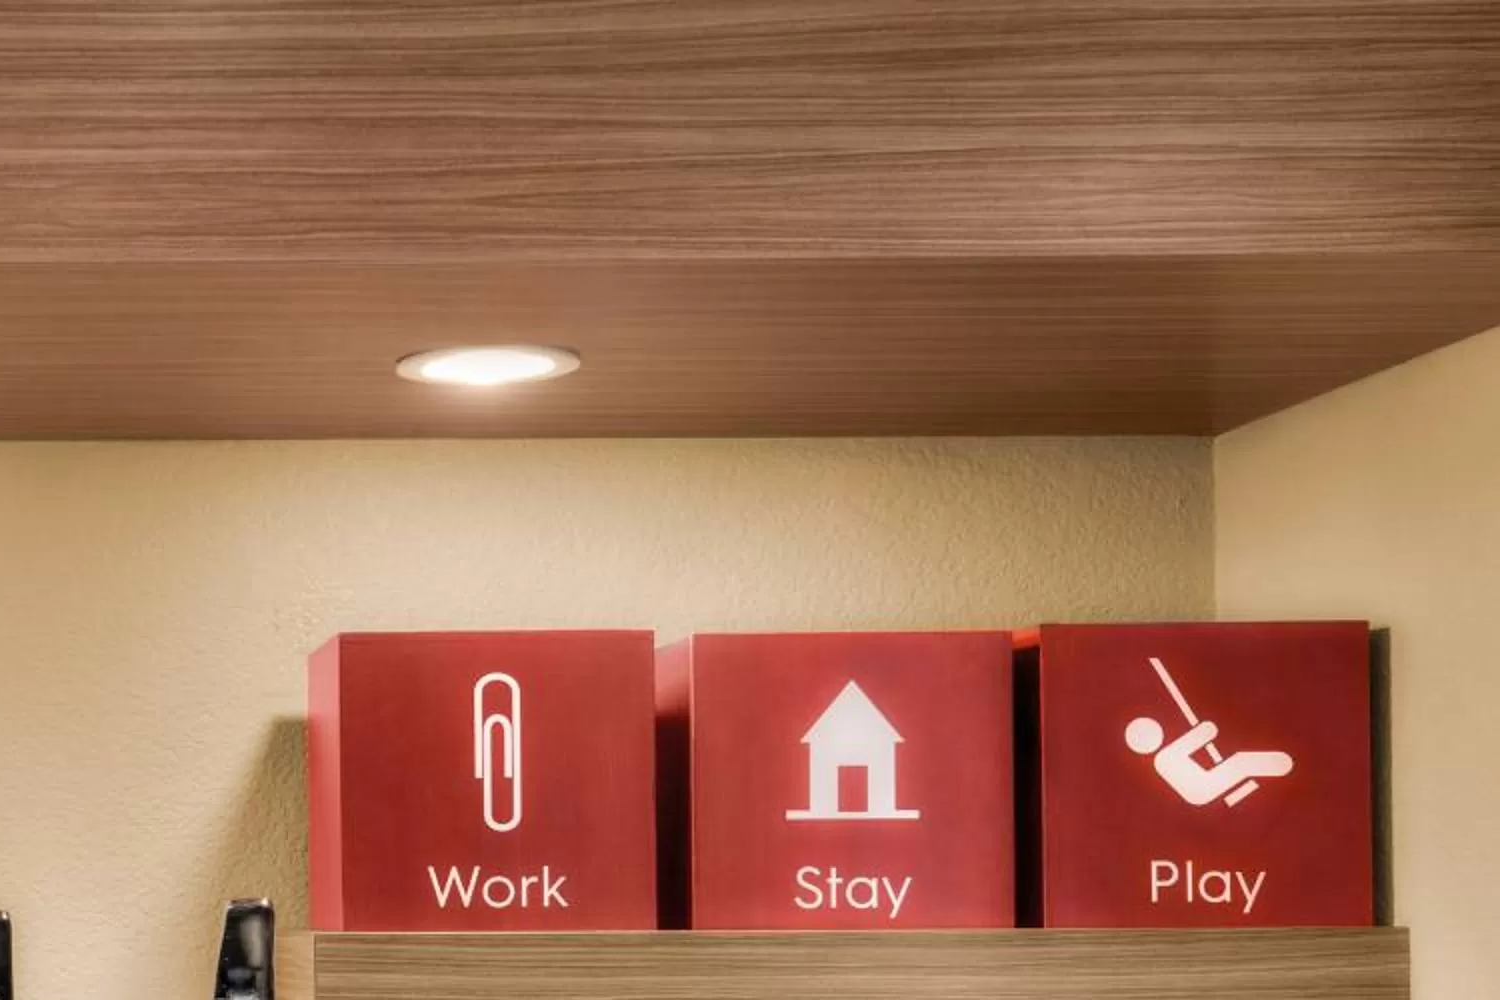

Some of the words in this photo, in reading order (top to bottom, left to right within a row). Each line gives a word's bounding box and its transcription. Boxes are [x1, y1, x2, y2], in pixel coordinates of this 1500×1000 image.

[427, 864, 569, 908] Work
[793, 865, 912, 919] Stay
[1150, 859, 1267, 914] Play
